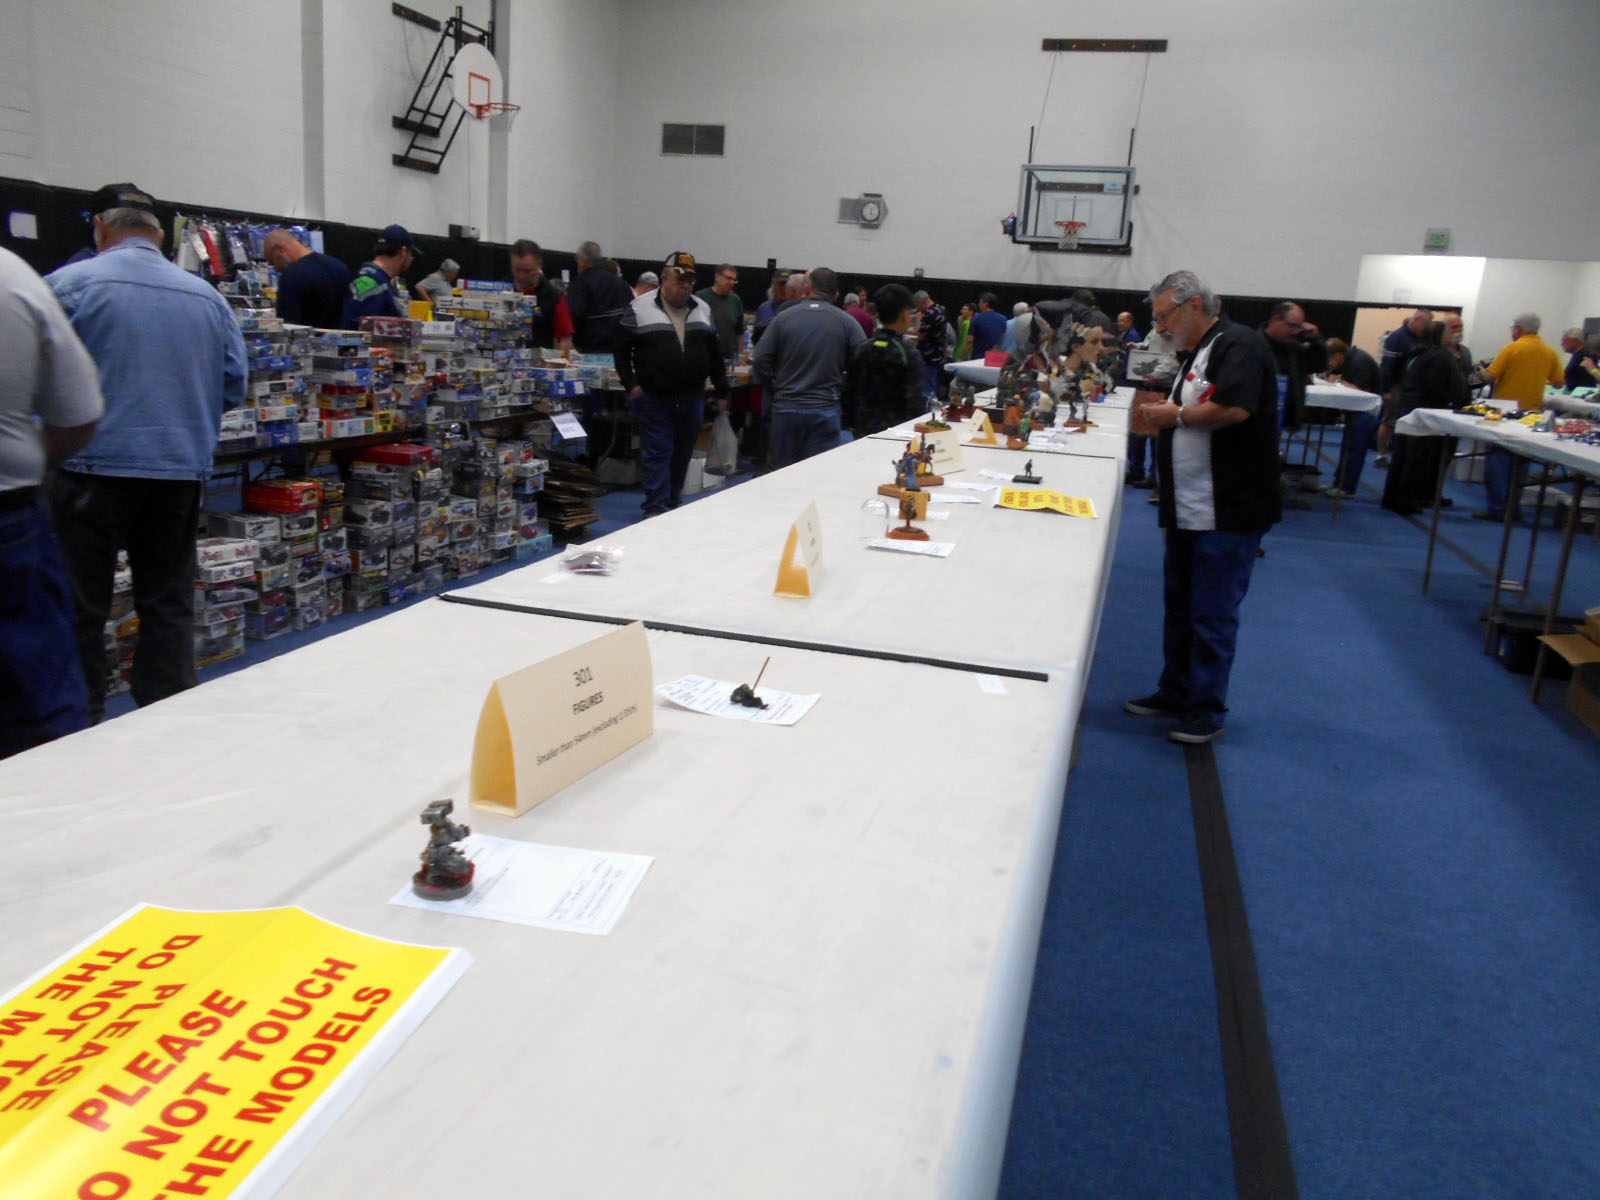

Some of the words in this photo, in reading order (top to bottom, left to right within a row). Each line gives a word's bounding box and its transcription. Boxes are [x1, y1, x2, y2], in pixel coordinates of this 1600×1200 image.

[572, 666, 593, 687] 301
[572, 691, 604, 716] FIGURES
[35, 948, 138, 1001] THE
[137, 935, 203, 970] DO
[43, 980, 144, 1043] NOT
[0, 983, 188, 1112] PLEASE
[67, 989, 248, 1132] PLEASE
[77, 1171, 132, 1200] O
[121, 1072, 231, 1161] NOT
[219, 957, 358, 1064] TOUCH
[234, 986, 392, 1124] MODELS
